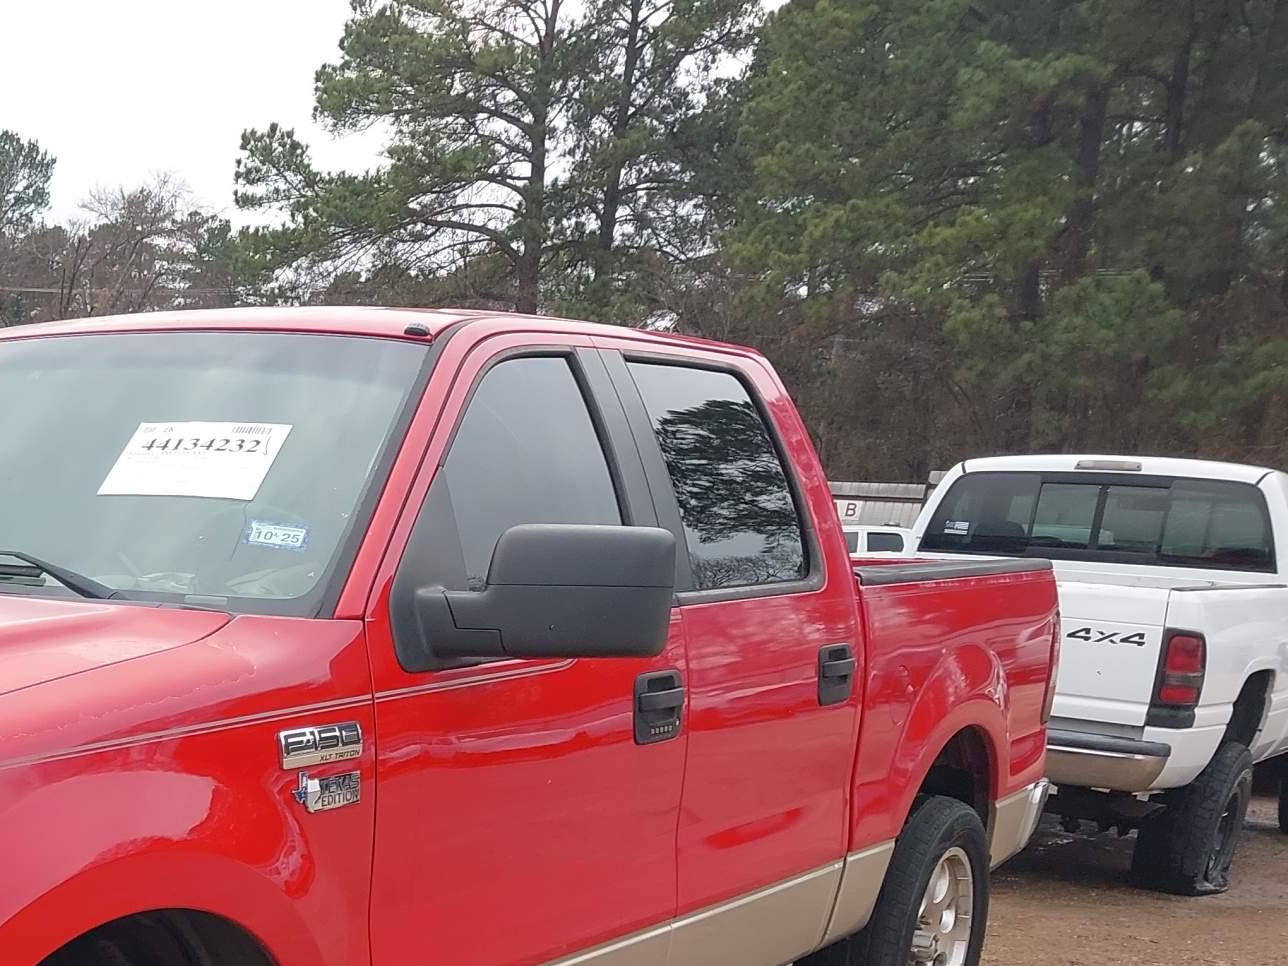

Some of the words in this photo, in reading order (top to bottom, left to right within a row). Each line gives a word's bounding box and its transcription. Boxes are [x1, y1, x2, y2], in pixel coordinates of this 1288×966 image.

[141, 438, 262, 453] 44134232
[844, 502, 857, 517] B
[255, 530, 273, 541] 10
[280, 533, 301, 543] 25
[320, 753, 333, 761] XLT
[335, 749, 360, 760] TRITON
[320, 773, 360, 794] TEXAS
[321, 788, 360, 807] EDITION
